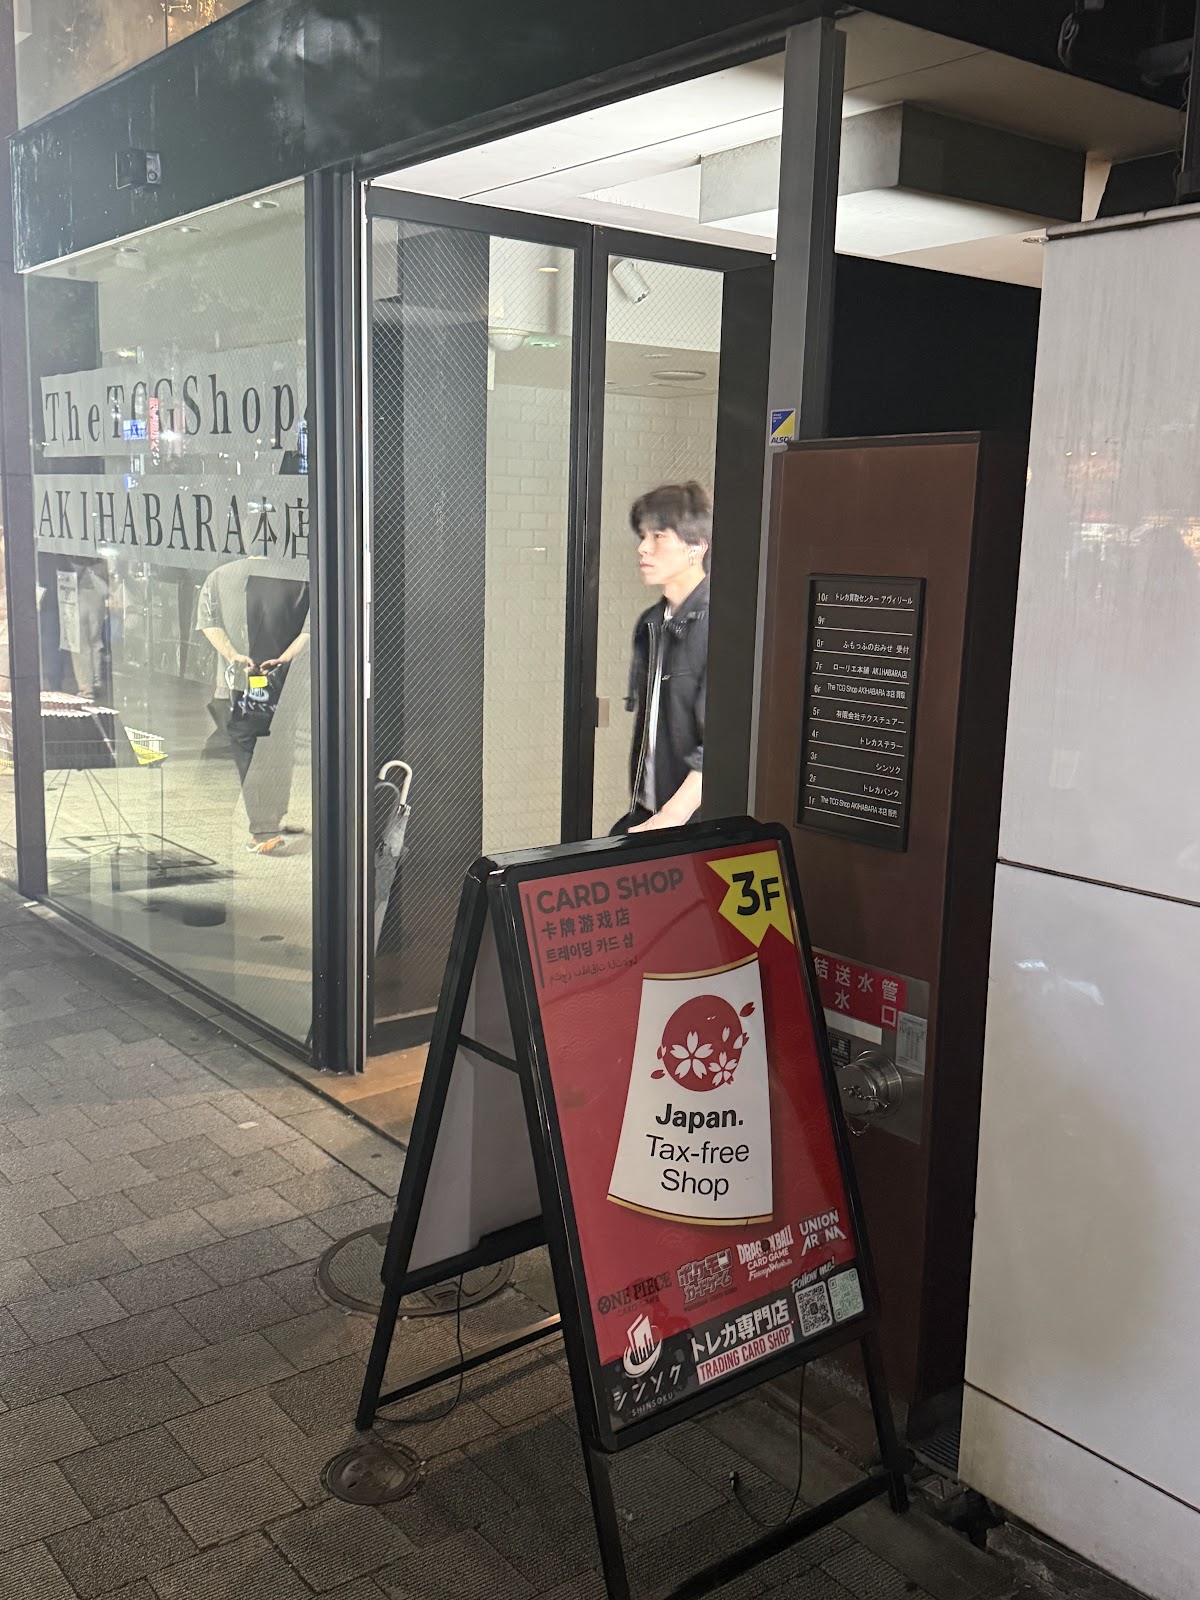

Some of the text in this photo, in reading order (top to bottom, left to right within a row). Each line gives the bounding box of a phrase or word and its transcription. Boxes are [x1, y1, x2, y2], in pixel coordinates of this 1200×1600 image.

[818, 615, 825, 625] 9F
[816, 639, 824, 648] 8F
[843, 641, 893, 653] ふもっふのおみせ
[815, 662, 823, 670] 7F
[814, 684, 821, 693] 6F
[812, 707, 905, 725] 5F 有限会社テクスチュアー
[811, 729, 903, 750] 4F トレカステラー
[810, 751, 901, 774] 3F シンソク
[809, 773, 817, 783] 2F
[808, 796, 815, 805] 1F
[536, 867, 684, 914] CARD SHOP
[732, 870, 781, 916] 3F
[541, 907, 631, 941] 卡牌游戏店
[546, 940, 593, 963] 트레이딩
[597, 935, 620, 953] 카드
[655, 1103, 744, 1134] Japan.
[646, 1133, 750, 1164] Tax-free
[661, 1168, 729, 1201] Shop
[799, 1210, 839, 1236] UNION
[677, 1248, 732, 1287] ポケモン
[747, 1255, 768, 1271] CARD
[768, 1247, 789, 1261] GAME
[791, 1255, 835, 1293] Follow me!
[598, 1287, 630, 1315] ONE
[633, 1272, 672, 1300] PIECE
[691, 1298, 790, 1362] トレカ専門店
[700, 1326, 791, 1381] TRADING CARD SHOP
[613, 1364, 681, 1411] シンソク
[632, 1392, 674, 1416] SHINSOKU
